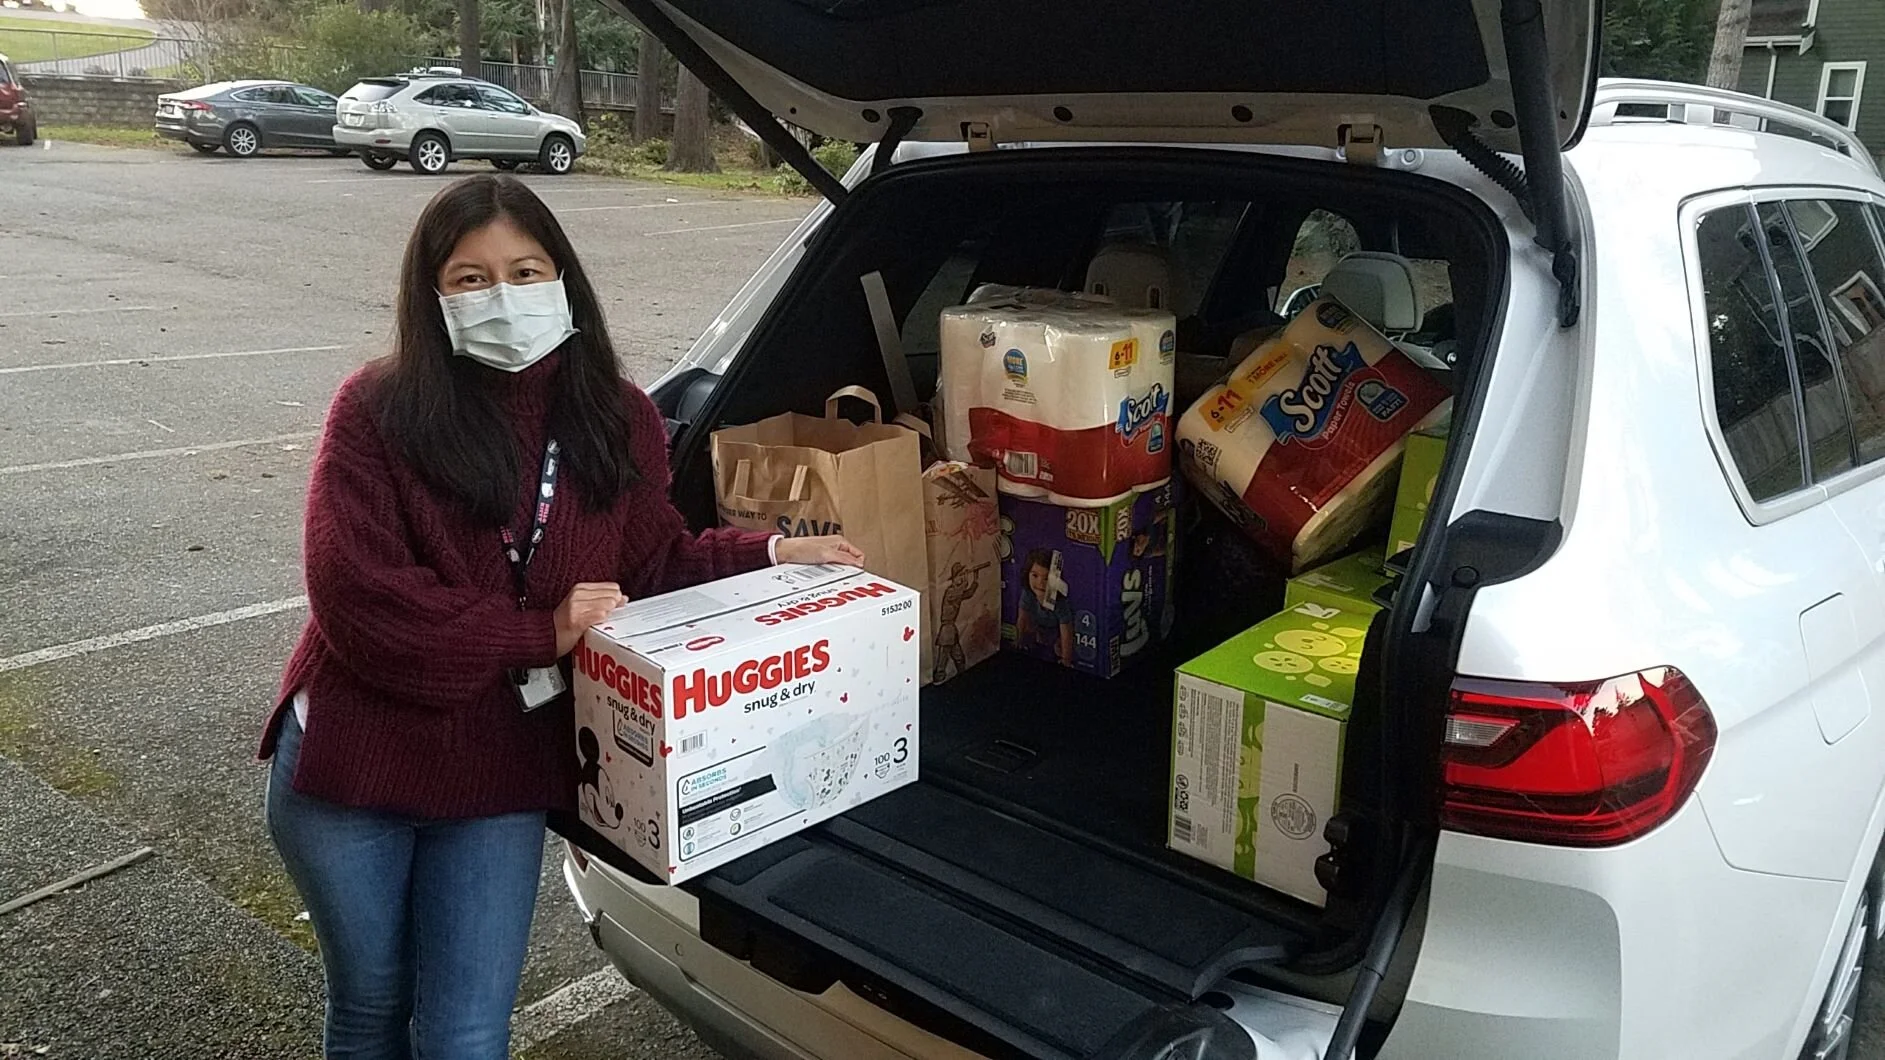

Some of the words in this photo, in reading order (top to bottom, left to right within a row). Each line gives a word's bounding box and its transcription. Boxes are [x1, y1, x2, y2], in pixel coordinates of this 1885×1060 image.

[1279, 345, 1342, 433] Scott
[1126, 382, 1161, 432] Scott
[1323, 411, 1340, 440] Paper
[1339, 380, 1356, 413] Towels
[738, 510, 755, 520] WAY
[757, 512, 768, 521] TO
[1067, 510, 1100, 536] 20X
[1117, 506, 1129, 541] 20X
[755, 582, 897, 626] HUGGIES
[1081, 614, 1090, 627] 4
[1075, 633, 1096, 649] 144
[673, 639, 830, 720] HUGGIES
[744, 693, 778, 713] snug
[779, 688, 791, 701] &
[793, 681, 815, 697] dry
[607, 695, 629, 721] snug
[630, 708, 638, 722] &
[638, 713, 655, 736] dry
[874, 752, 890, 765] 100
[893, 737, 908, 763] 3
[691, 767, 726, 785] ABSORBS
[648, 818, 660, 850] 3
